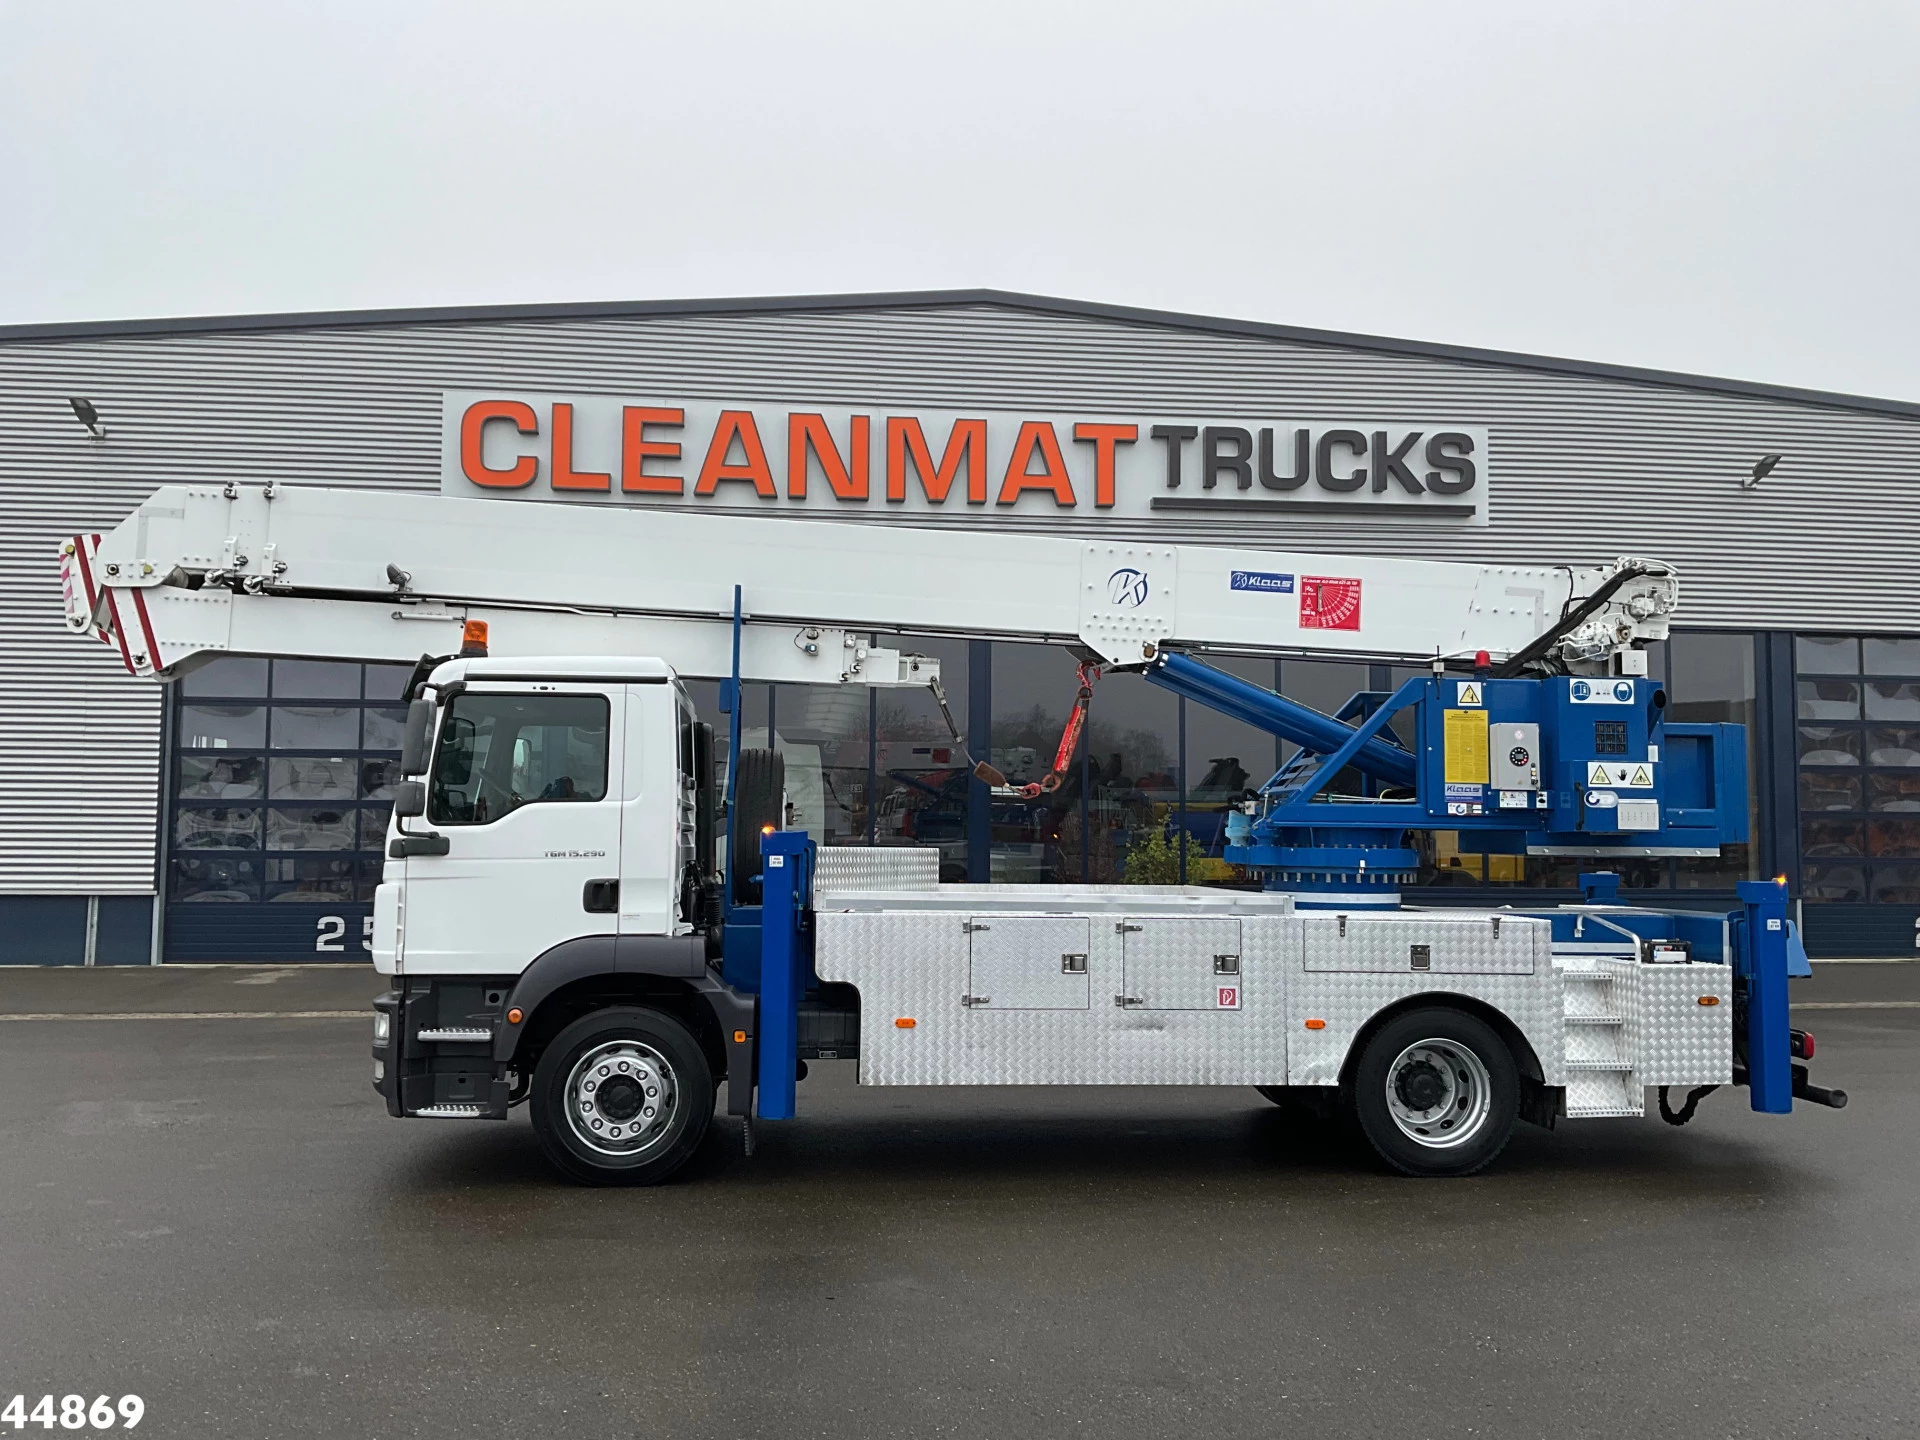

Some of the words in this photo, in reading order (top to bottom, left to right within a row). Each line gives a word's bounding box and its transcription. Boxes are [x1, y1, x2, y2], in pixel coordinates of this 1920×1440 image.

[461, 400, 1138, 508] CLEANMAT
[1150, 425, 1476, 494] TRUCKS
[1248, 576, 1292, 587] Klaas
[1446, 784, 1481, 792] Klaas
